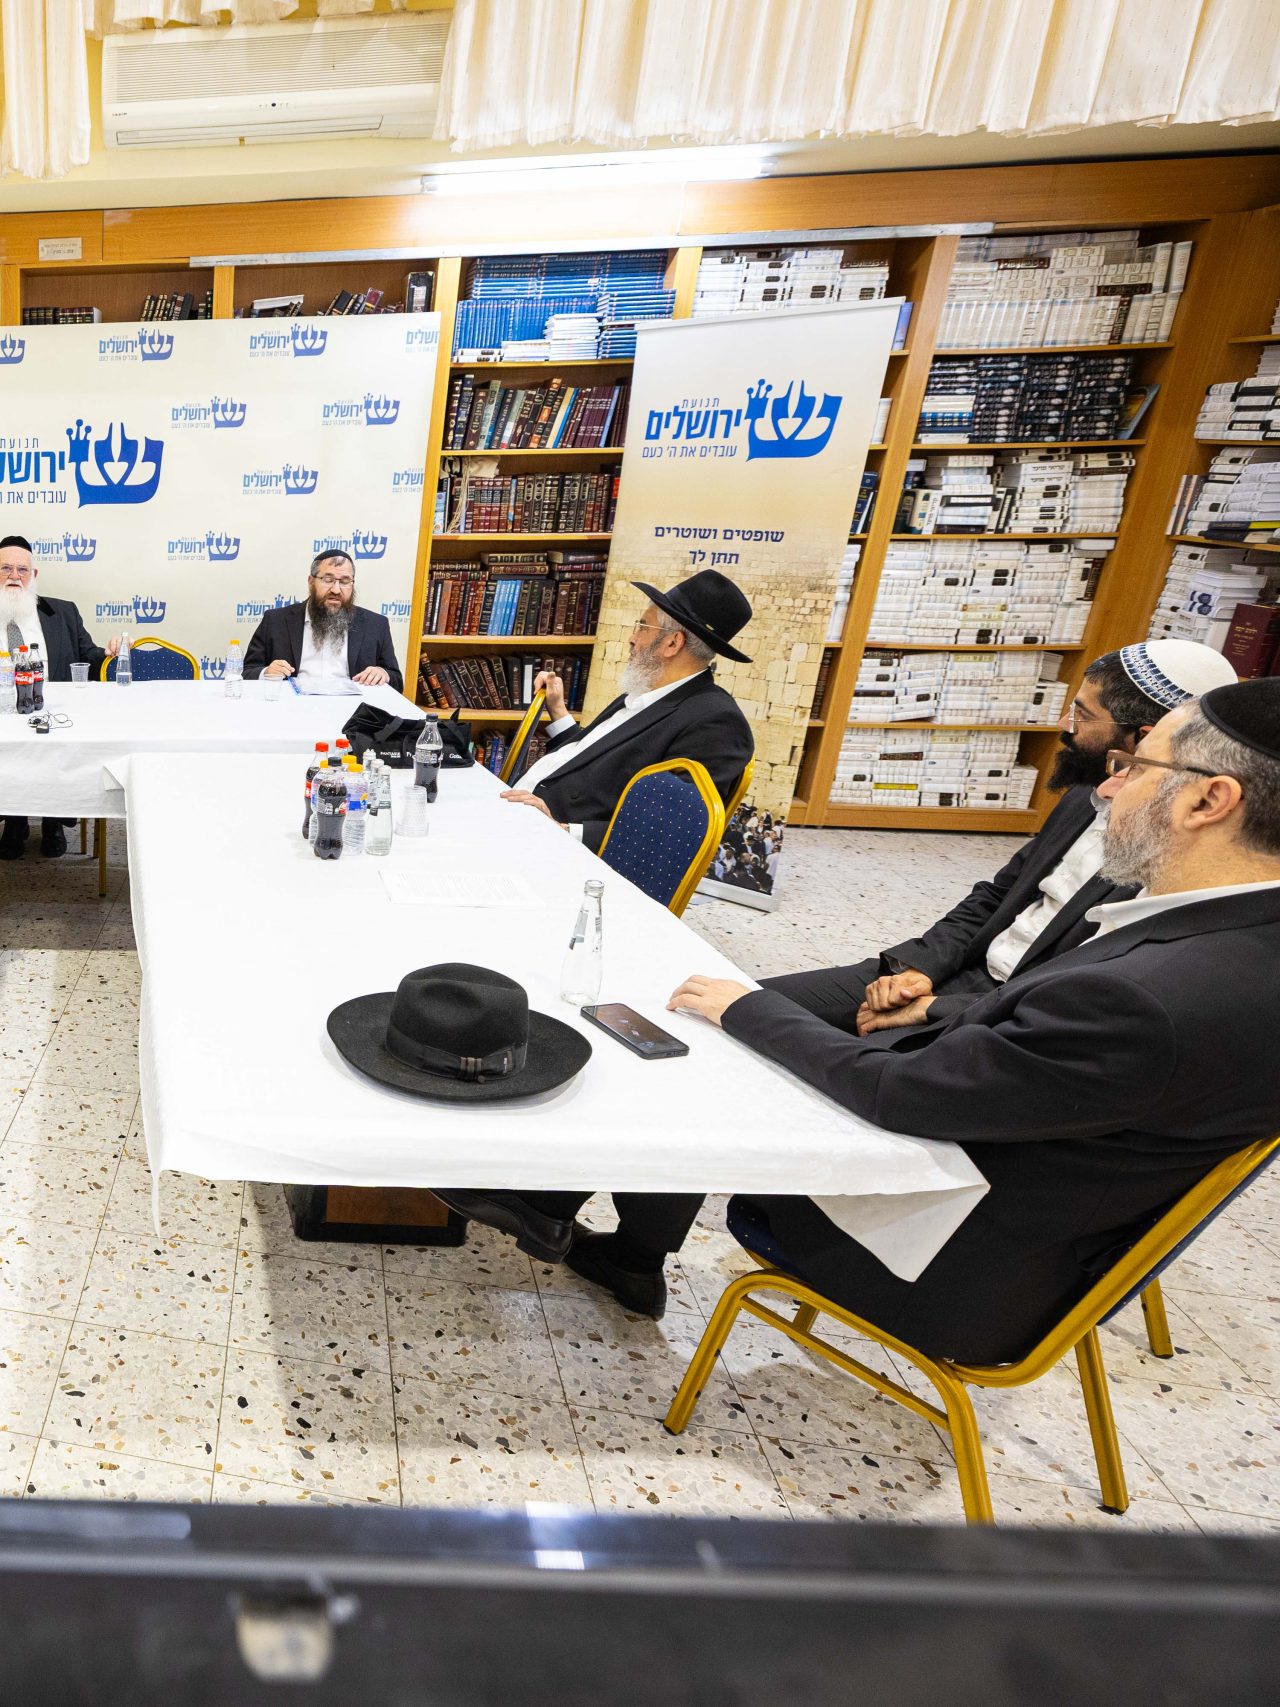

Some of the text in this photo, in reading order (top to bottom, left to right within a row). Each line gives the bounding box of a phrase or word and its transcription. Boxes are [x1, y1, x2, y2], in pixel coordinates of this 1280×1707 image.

[250, 333, 289, 349] ירושלים
[406, 329, 439, 344] ושלים
[99, 338, 137, 353] ירושלים
[681, 398, 720, 408] תנועת
[172, 406, 210, 420] ירושלים
[323, 403, 363, 417] ירושלים
[645, 406, 742, 440] ירושלים
[0, 438, 39, 449] תנועת
[642, 446, 737, 458] עובדים את ה' כעם
[243, 473, 282, 487] ירושלים
[7, 491, 23, 504] את
[28, 491, 66, 504] עובדים
[654, 526, 784, 543] שופטים ושוטרים
[30, 541, 62, 554] ירושלי
[168, 540, 205, 553] ירושלים
[689, 550, 739, 566] תתן לך
[96, 603, 132, 616] ירושלים
[381, 603, 412, 616] ושלים
